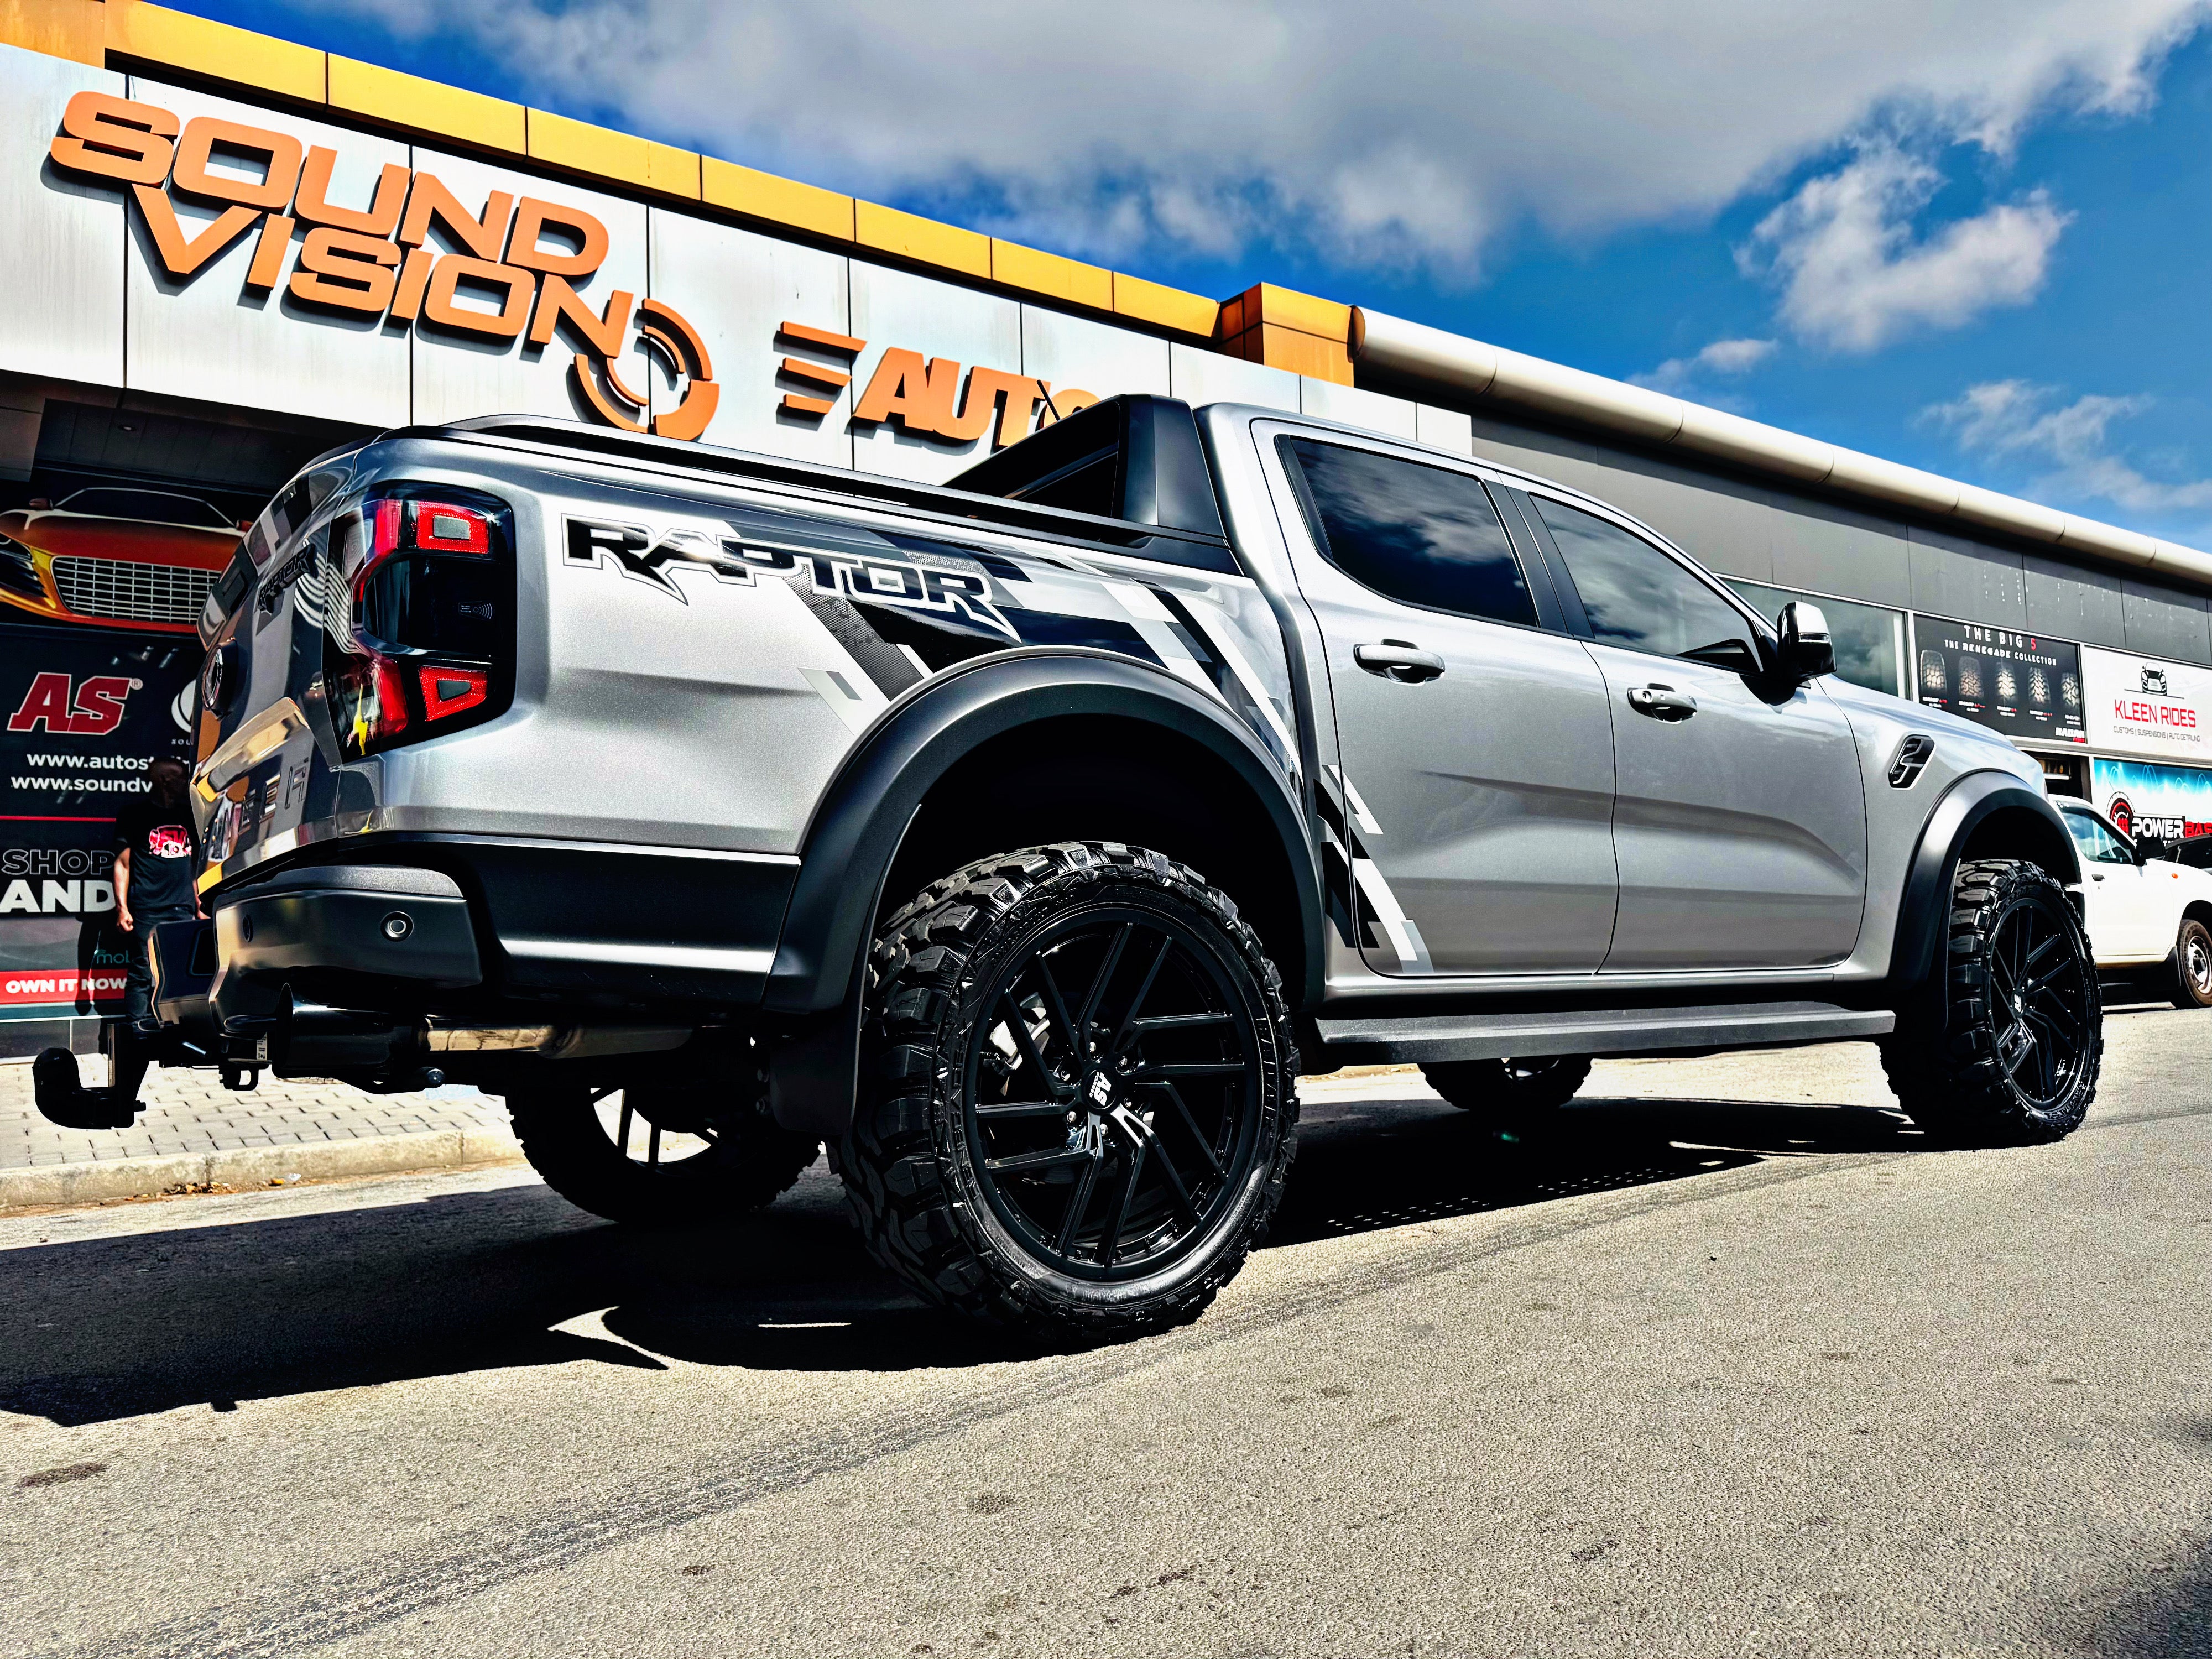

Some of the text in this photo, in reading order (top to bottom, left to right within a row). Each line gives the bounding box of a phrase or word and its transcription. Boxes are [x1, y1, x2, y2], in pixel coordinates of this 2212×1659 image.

[51, 90, 609, 276] SOUND
[132, 184, 634, 358] VISION
[561, 512, 1022, 644] RAPTOR
[1964, 625, 2037, 650] THE BIG 5
[1944, 639, 2057, 666] THE RENEGADE COLLECTION
[7, 672, 131, 735] AS
[2114, 699, 2196, 728] KLEEN RIDES
[2114, 726, 2134, 734] CUSTOMS
[1, 849, 116, 875] SHOP
[6, 977, 127, 994] OWN IT NOW
[1094, 1072, 1112, 1107] AS
